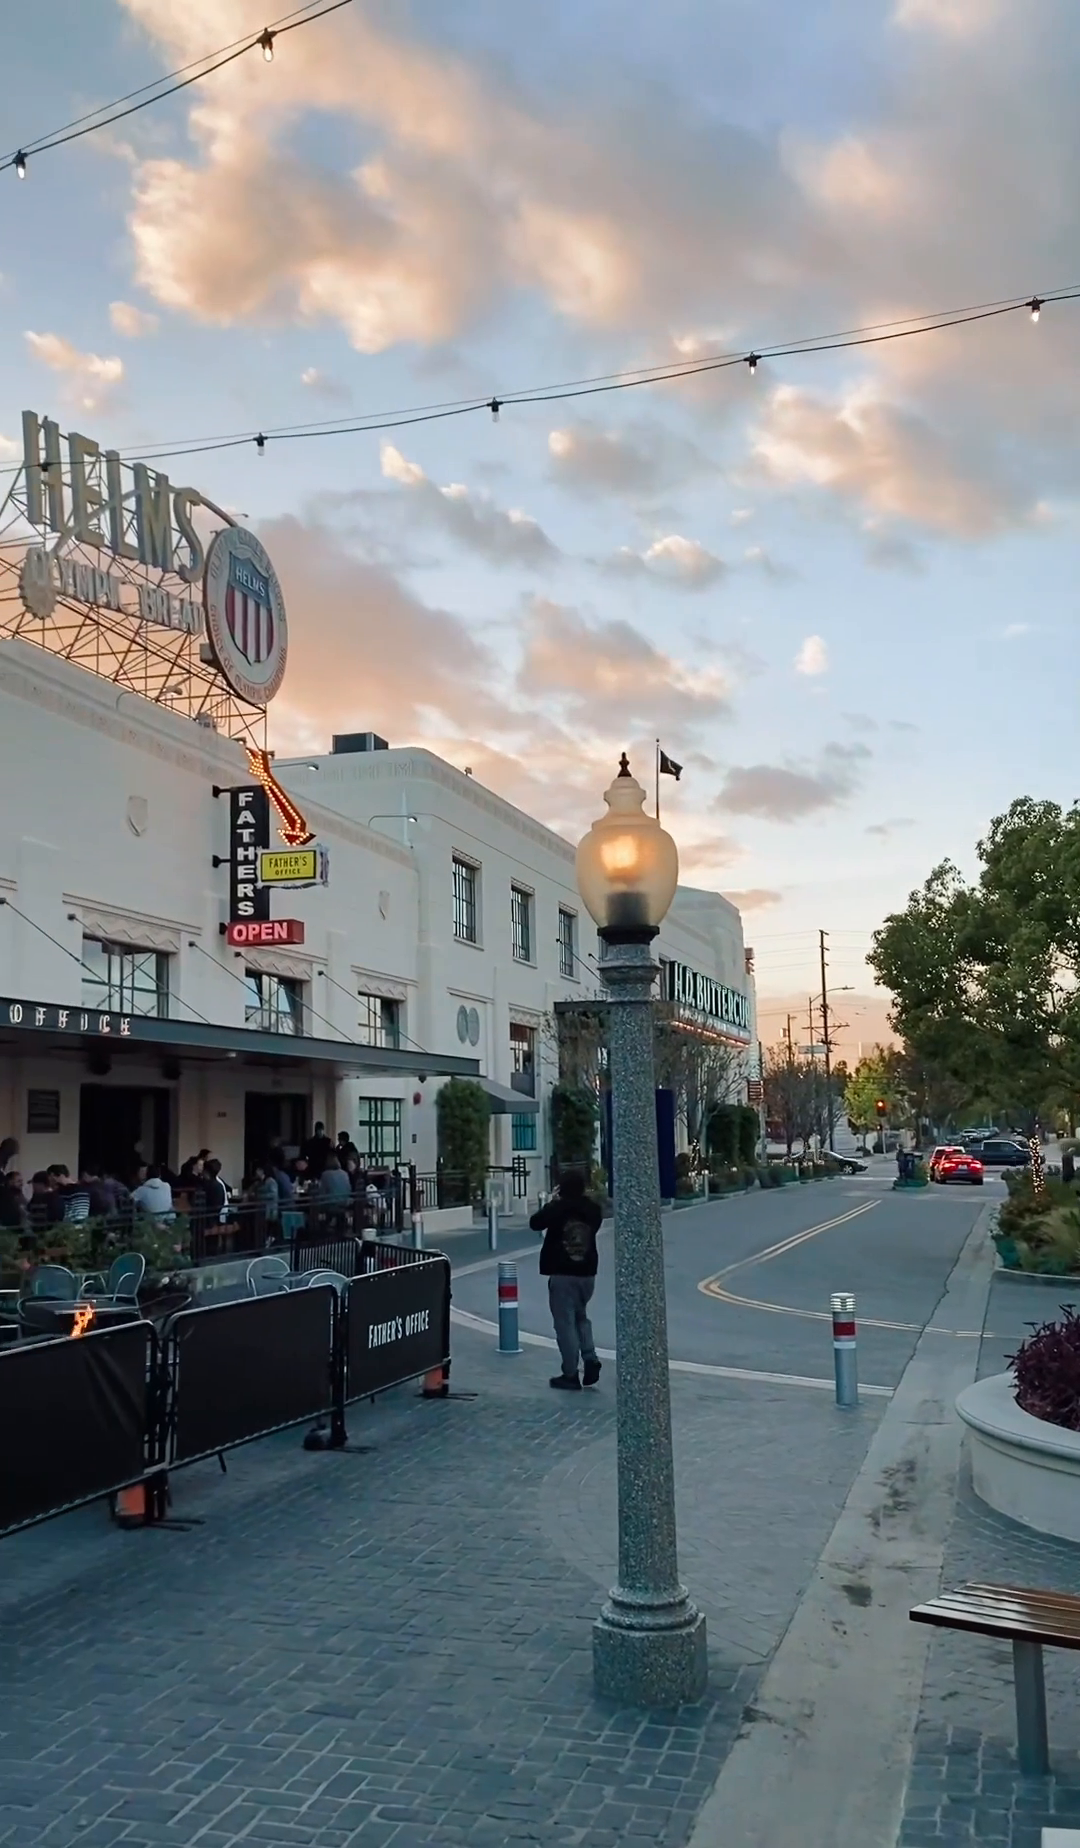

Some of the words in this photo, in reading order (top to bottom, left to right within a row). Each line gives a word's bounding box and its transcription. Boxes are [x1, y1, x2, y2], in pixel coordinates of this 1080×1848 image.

[22, 410, 204, 583] HELMS
[235, 566, 265, 597] HELMS
[236, 792, 256, 916] FATHERS
[268, 855, 308, 869] FATHER'S
[275, 868, 301, 876] OFFICE
[232, 922, 288, 942] OPEN
[9, 1003, 131, 1036] OFFICE
[368, 1316, 403, 1349] FATHER'S
[405, 1309, 430, 1337] OFFICE
